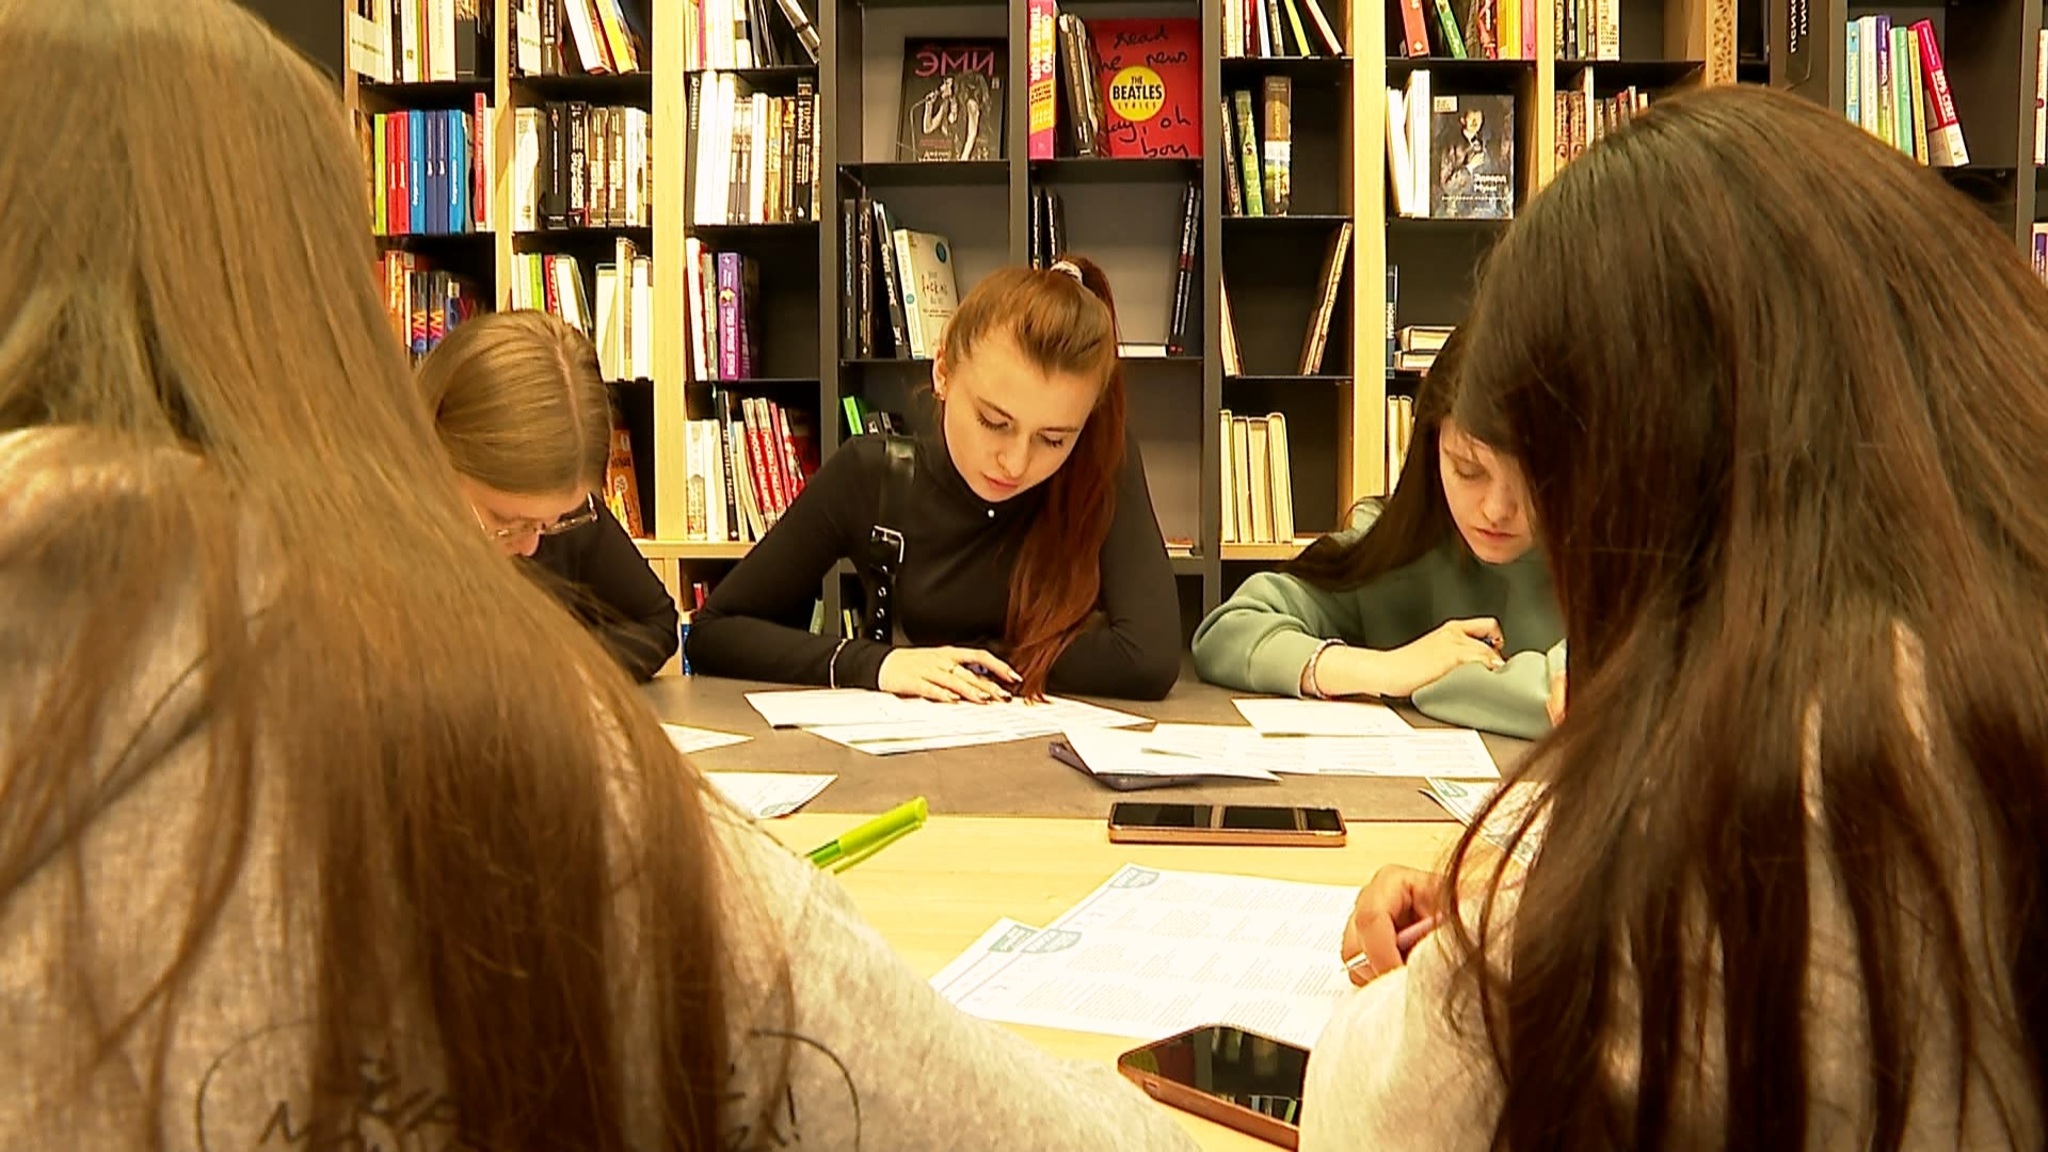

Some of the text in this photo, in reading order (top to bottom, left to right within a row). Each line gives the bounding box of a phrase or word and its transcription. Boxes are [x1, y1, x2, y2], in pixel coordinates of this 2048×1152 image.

[1041, 14, 1052, 41] ONE
[1113, 24, 1169, 49] read
[1030, 5, 1041, 81] THREE FOUR
[915, 51, 995, 77] ЭМИ
[1041, 46, 1052, 73] TWO
[1146, 51, 1188, 67] news
[1131, 75, 1143, 84] THE
[1113, 85, 1162, 100] BEATLES
[1118, 101, 1157, 110] LYRICS
[1160, 105, 1191, 129] oh
